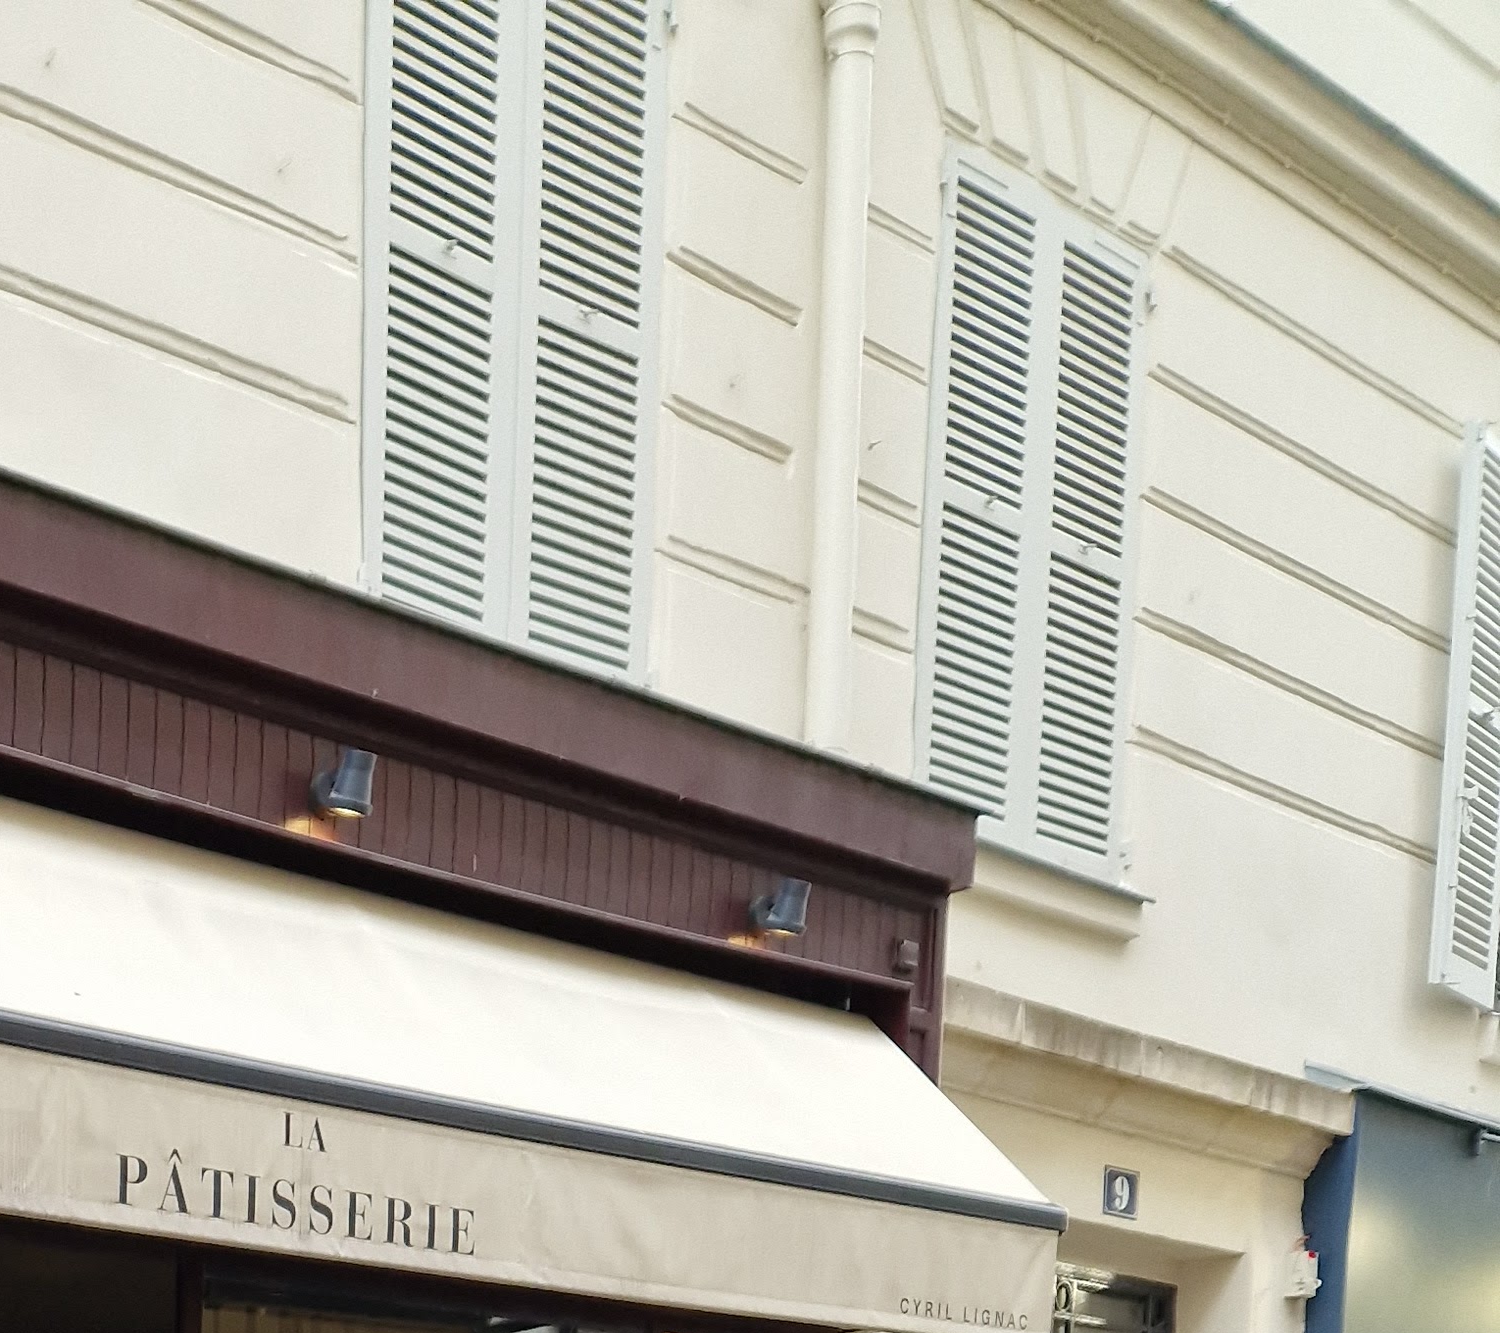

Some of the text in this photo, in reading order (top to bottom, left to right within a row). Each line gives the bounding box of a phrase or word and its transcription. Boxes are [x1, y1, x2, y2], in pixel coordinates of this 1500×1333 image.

[283, 1111, 326, 1152] LA
[115, 1148, 476, 1256] PÂTISSERIE
[1114, 1175, 1131, 1212] 9
[900, 1298, 1030, 1330] CYRIL LIGNAC
